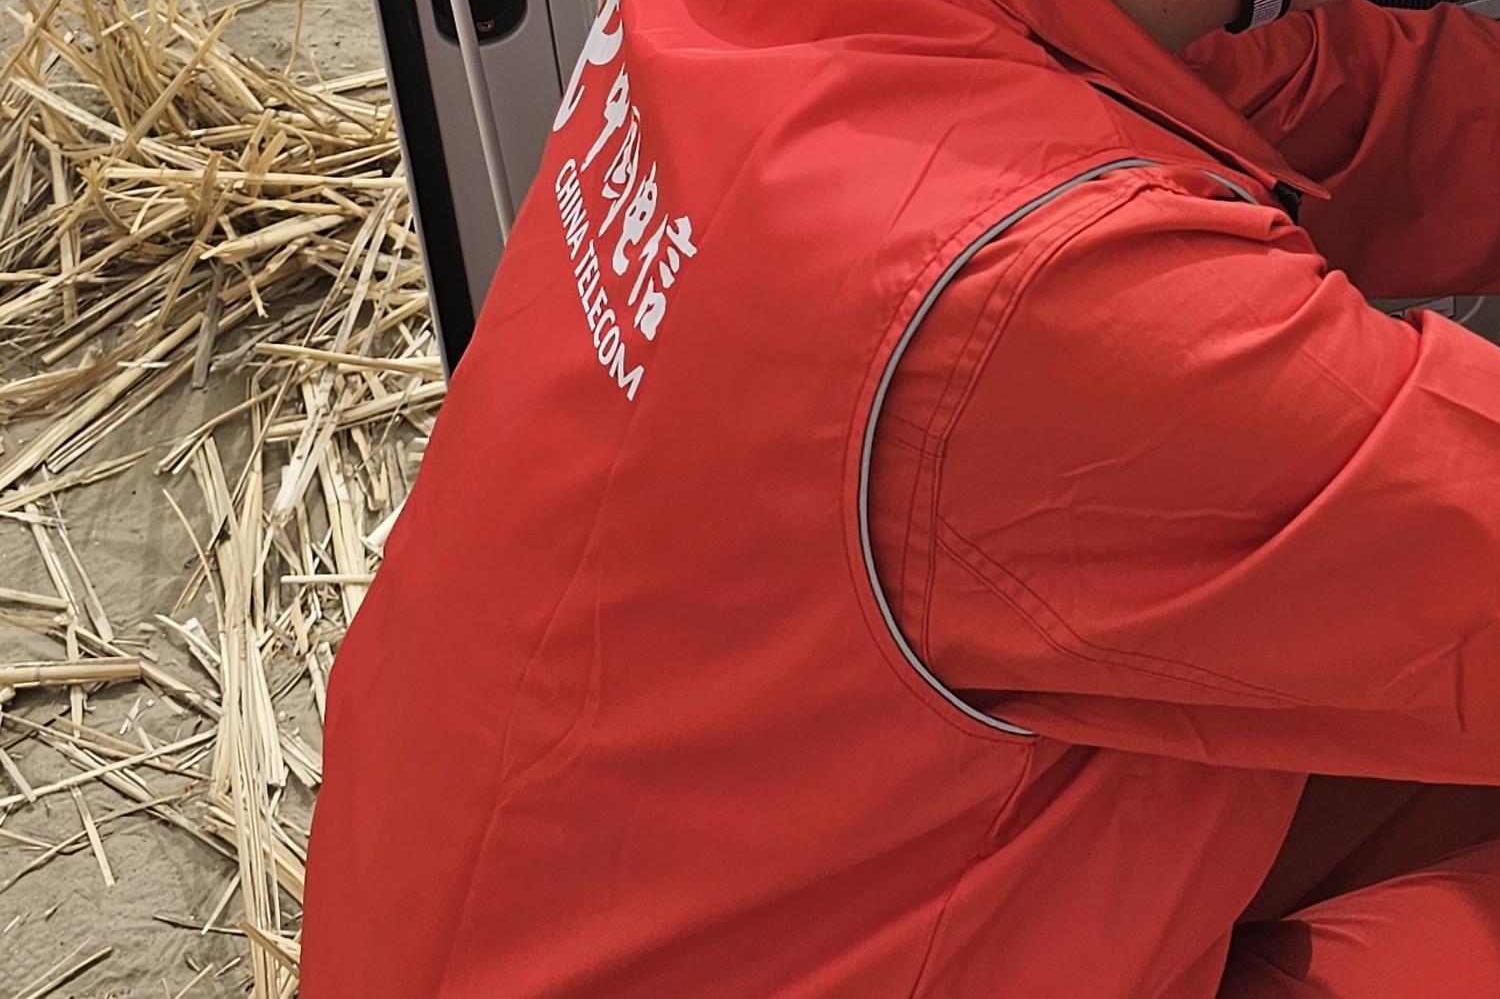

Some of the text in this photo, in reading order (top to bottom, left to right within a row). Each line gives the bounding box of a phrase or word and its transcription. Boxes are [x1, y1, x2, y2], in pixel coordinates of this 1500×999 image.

[556, 158, 645, 401] CHINA TELECOM
[581, 63, 697, 340] 中国电信
